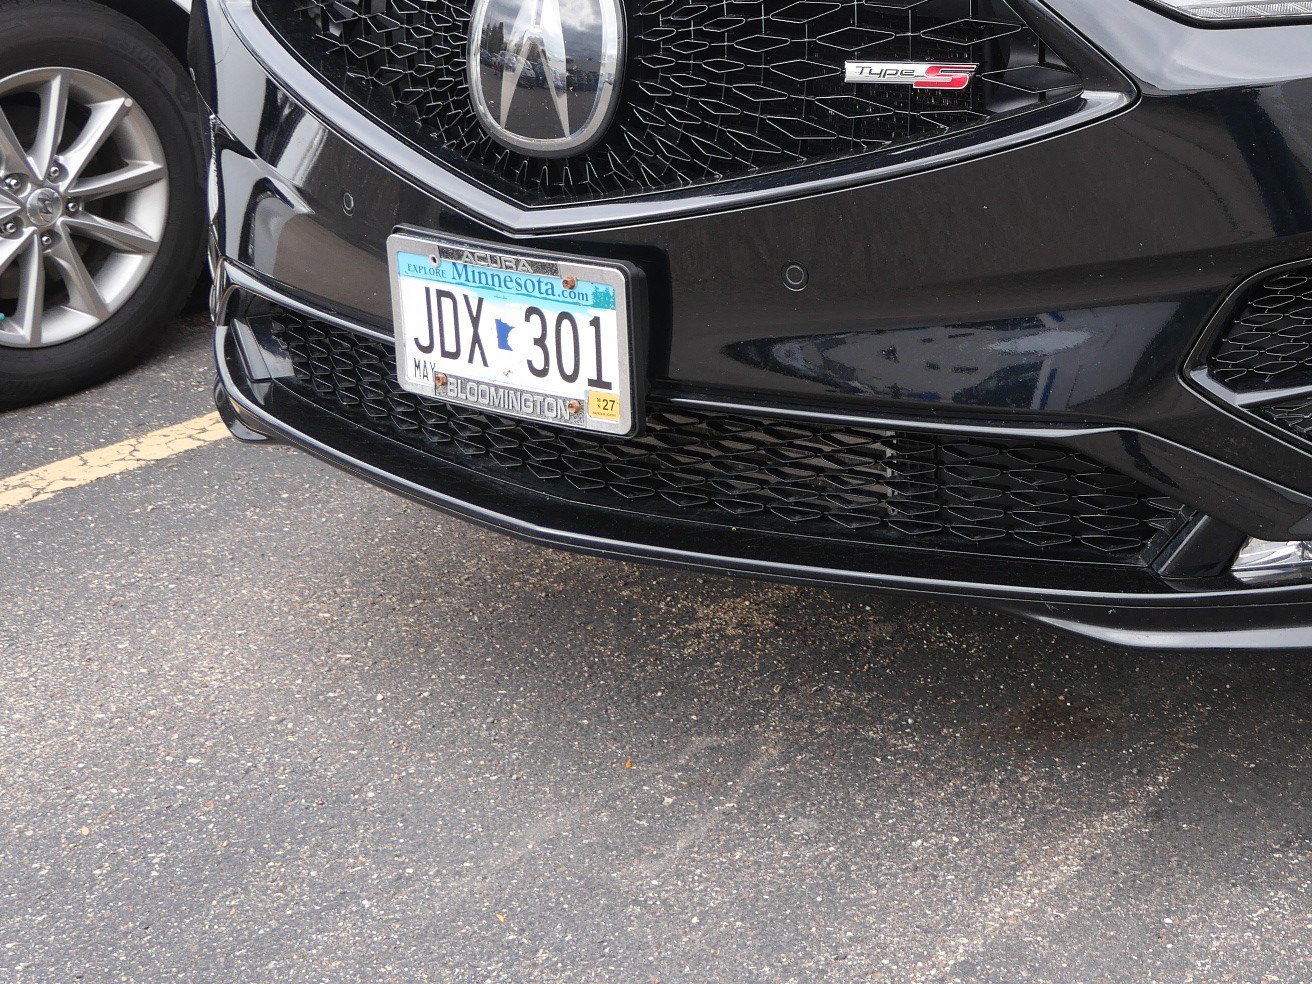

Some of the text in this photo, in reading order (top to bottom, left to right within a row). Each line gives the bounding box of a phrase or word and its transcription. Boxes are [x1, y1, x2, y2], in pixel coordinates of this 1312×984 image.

[855, 63, 977, 89] Type S
[407, 263, 446, 278] EXPLORE
[462, 251, 532, 272] ACURA
[413, 286, 612, 390] JDX 301
[414, 357, 436, 380] MAY
[447, 377, 571, 420] BLOOMINGTON
[602, 398, 615, 411] 27
